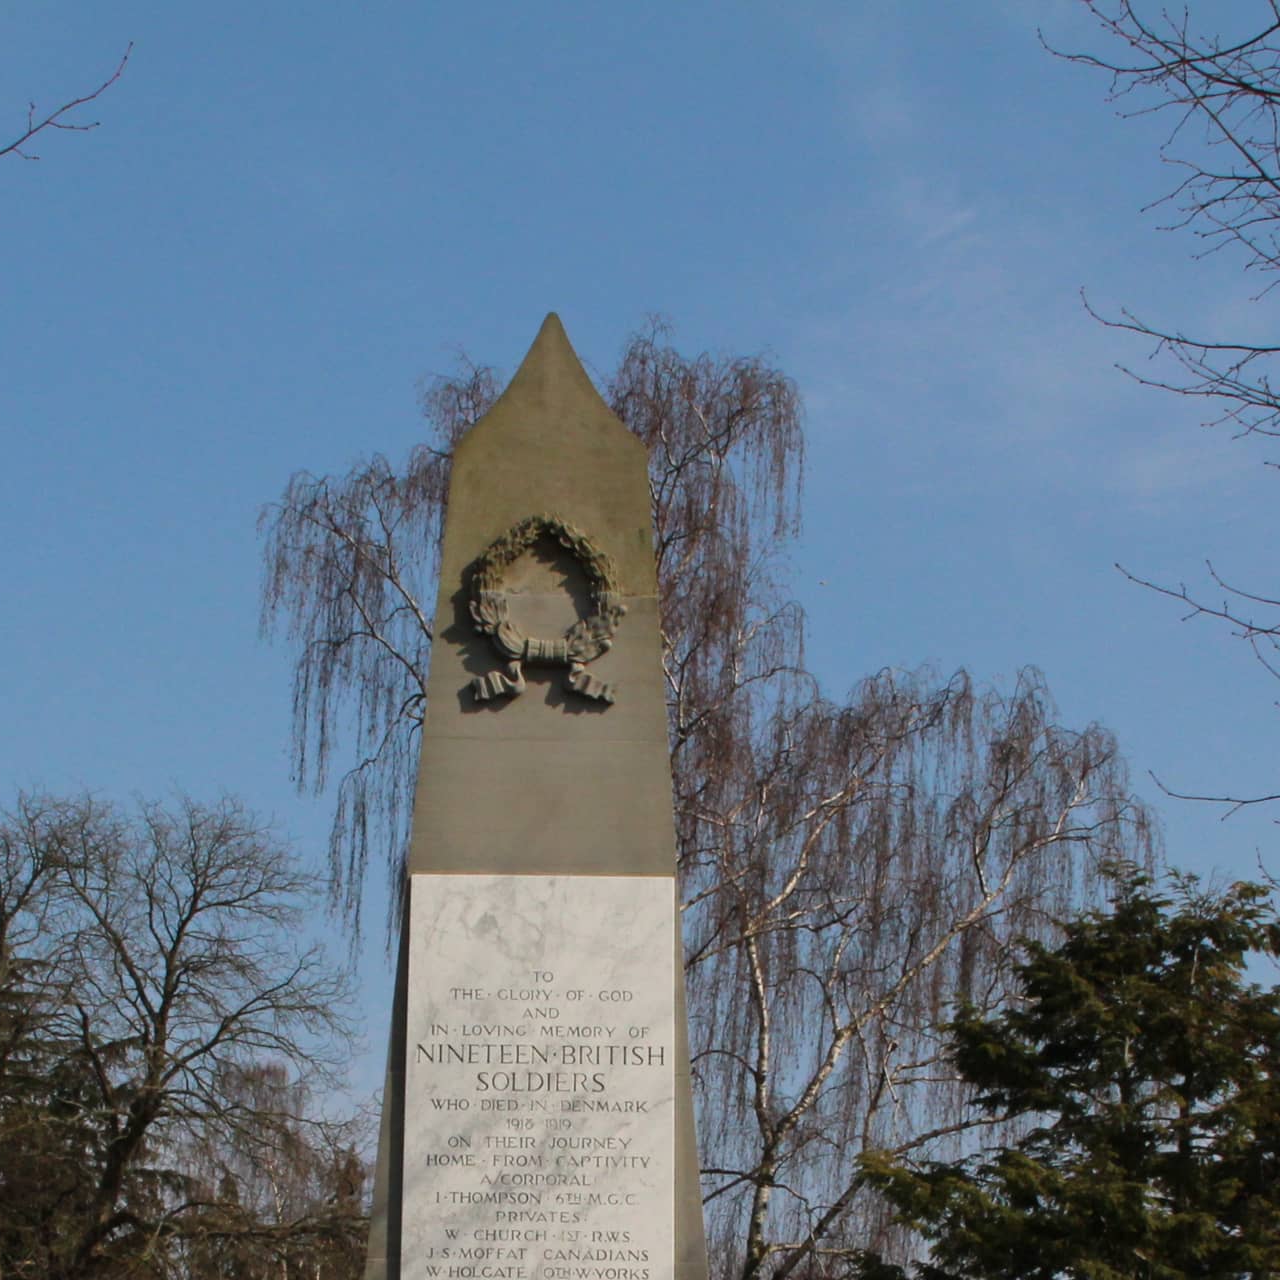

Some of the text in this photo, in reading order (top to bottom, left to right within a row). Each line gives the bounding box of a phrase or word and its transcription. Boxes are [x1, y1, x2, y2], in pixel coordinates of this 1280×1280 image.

[533, 971, 554, 983] TO
[450, 988, 633, 1002] THE GLORY OF GOD
[522, 1008, 560, 1019] AND
[431, 1024, 650, 1038] IN LOVING MEMORY OF
[417, 1044, 664, 1066] NINETEEN BRITISH
[476, 1072, 605, 1092] SOLDIERS
[431, 1099, 648, 1113] WHO DIED IN DENMARK
[448, 1135, 632, 1150] ON THEIR JOURNEY
[426, 1154, 651, 1169] HOME FROM CAPTIVITY
[480, 1170, 591, 1186] A/CORPORAL
[450, 1192, 541, 1205] THOMPSON
[445, 1229, 459, 1240] W
[474, 1229, 547, 1241] CHURCH
[442, 1248, 450, 1259] S
[459, 1248, 527, 1259] MOFFAT
[544, 1249, 649, 1262] CANADIANS
[426, 1266, 442, 1278] W
[449, 1266, 527, 1279] HOLGATE
[576, 1268, 589, 1279] W
[596, 1268, 649, 1280] YORKS
